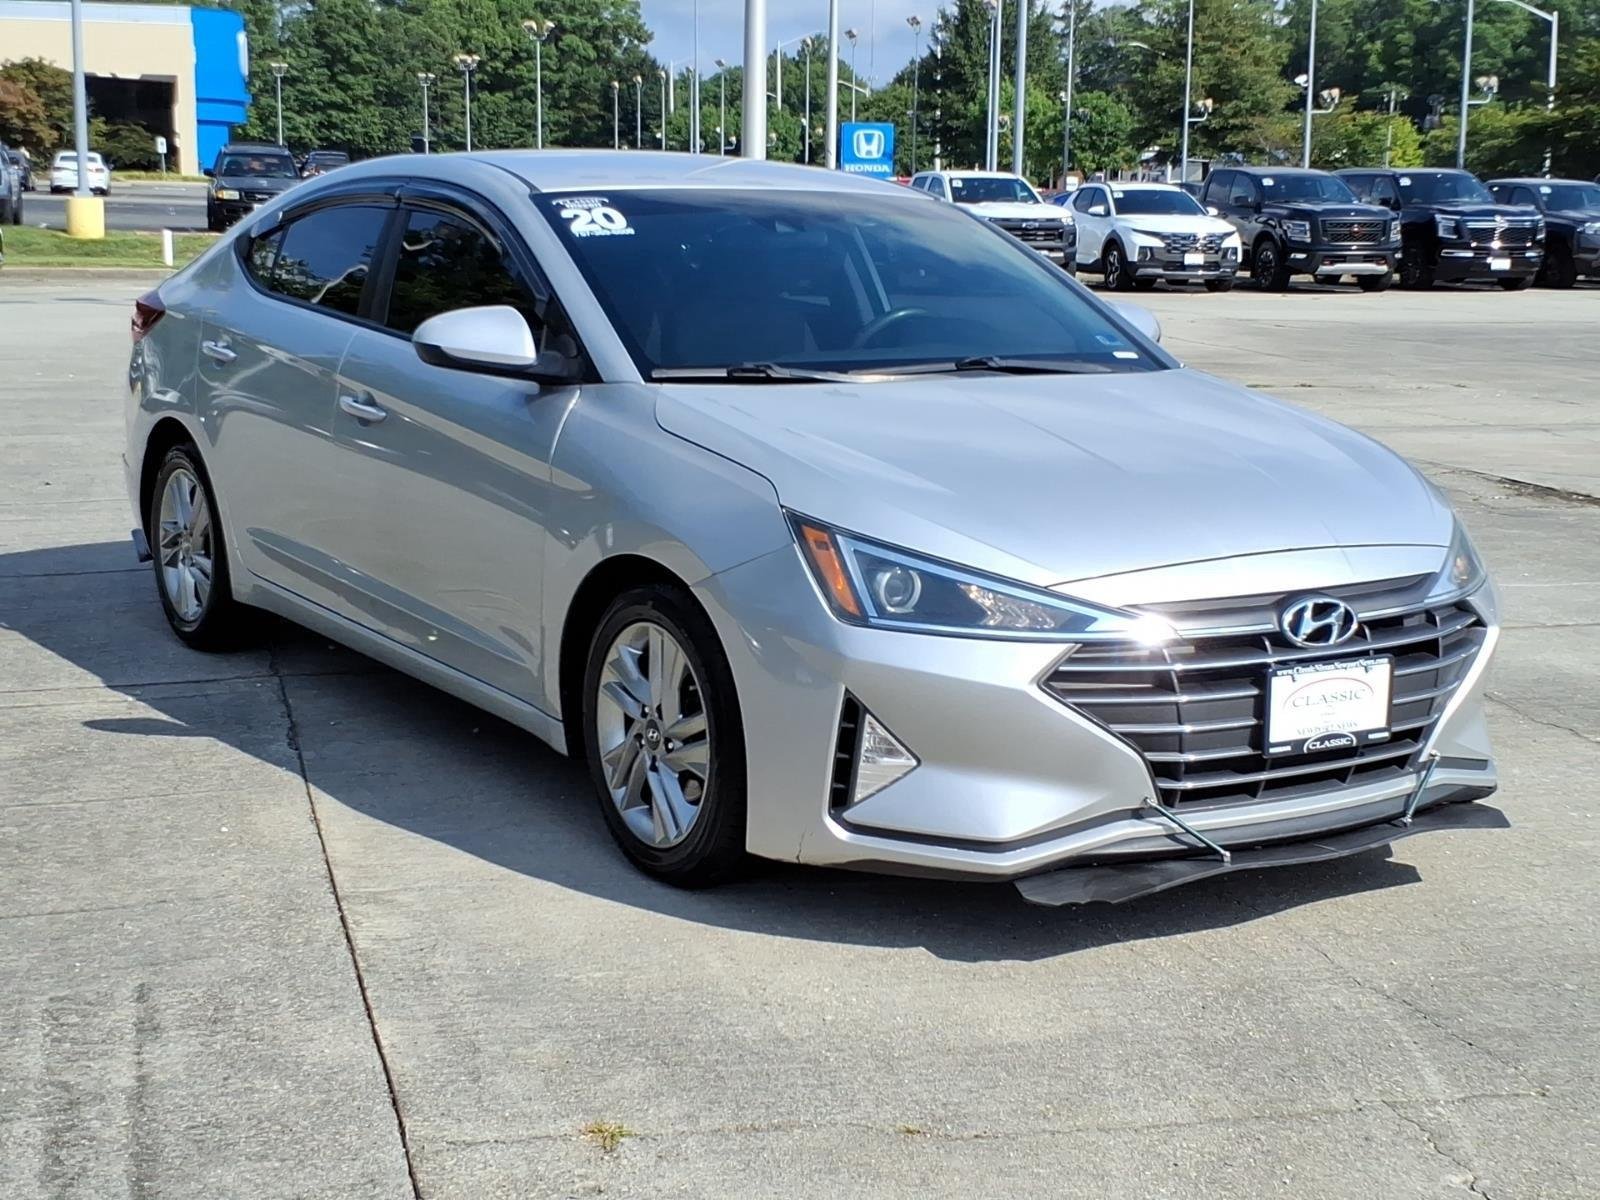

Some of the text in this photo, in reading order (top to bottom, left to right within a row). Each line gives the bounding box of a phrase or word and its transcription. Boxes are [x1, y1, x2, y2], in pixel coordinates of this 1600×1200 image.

[845, 164, 890, 172] HONDA
[561, 206, 627, 232] 20
[1292, 689, 1362, 708] CLASSIC
[1309, 737, 1352, 750] CLASSIC
